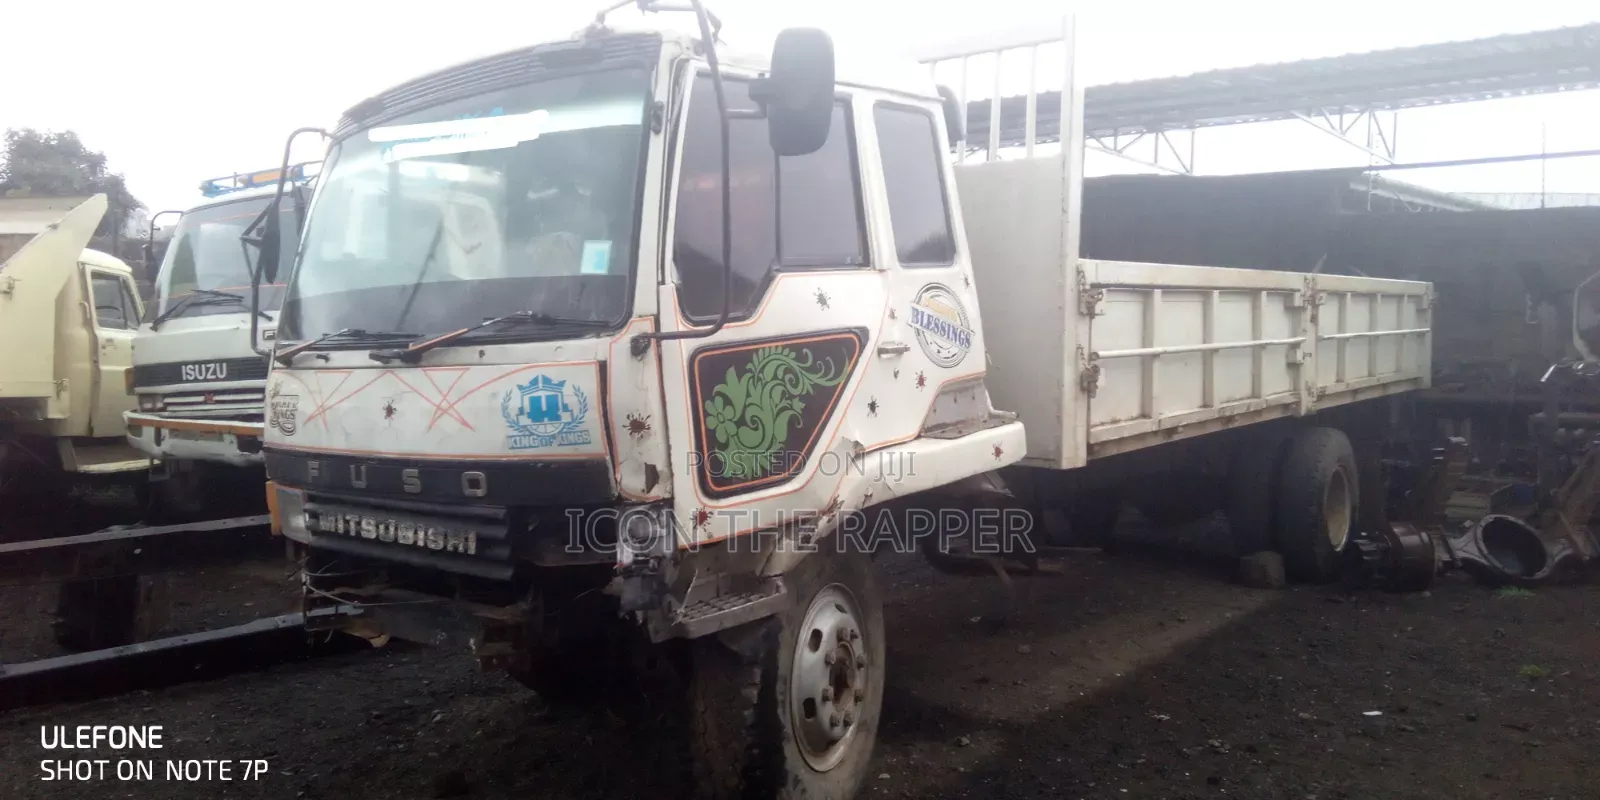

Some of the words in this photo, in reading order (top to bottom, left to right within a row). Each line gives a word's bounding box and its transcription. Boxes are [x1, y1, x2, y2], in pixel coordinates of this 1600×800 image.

[911, 306, 971, 349] BLESSINGS
[181, 362, 228, 380] ISUZU
[508, 435, 539, 449] KING
[557, 431, 591, 446] KINGS
[307, 460, 487, 497] FUSO
[318, 511, 477, 555] MITSUBISHI
